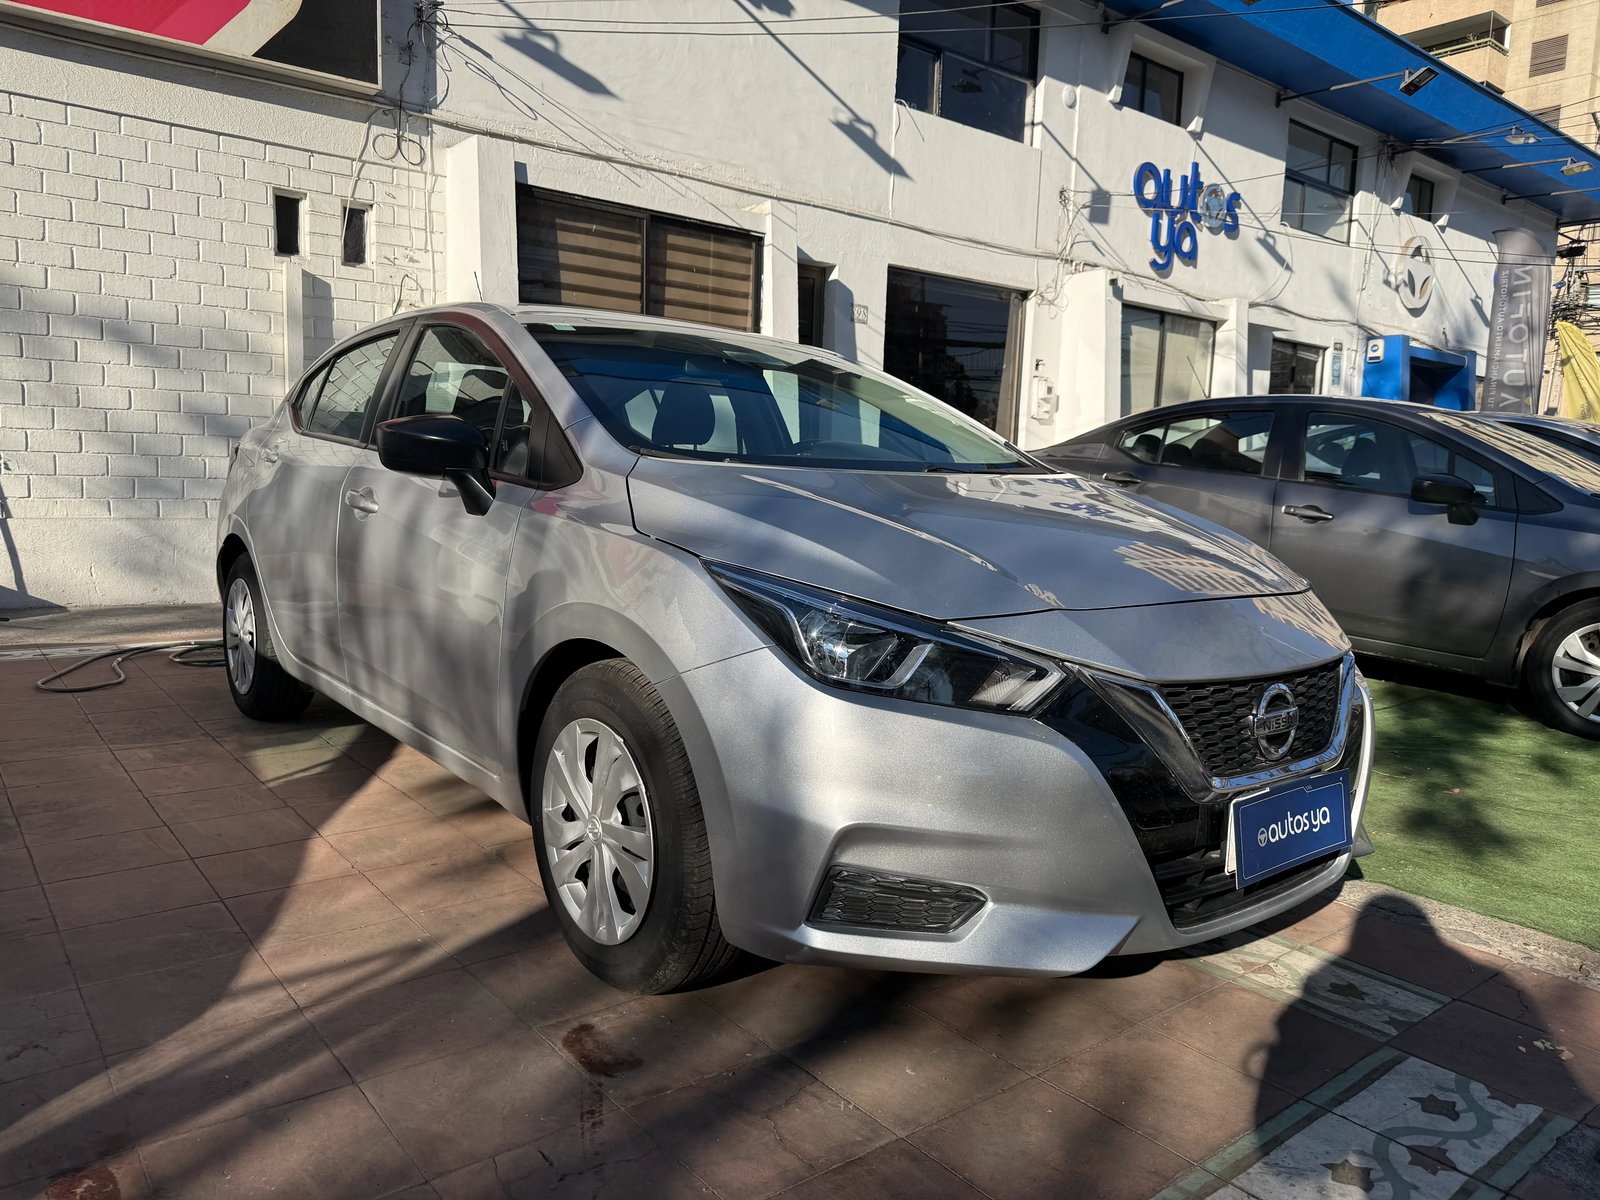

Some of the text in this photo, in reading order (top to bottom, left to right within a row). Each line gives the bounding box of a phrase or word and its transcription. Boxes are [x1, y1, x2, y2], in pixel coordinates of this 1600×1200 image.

[1132, 161, 1240, 233] autos
[1148, 209, 1199, 272] ya
[1268, 806, 1331, 843] autos ya
